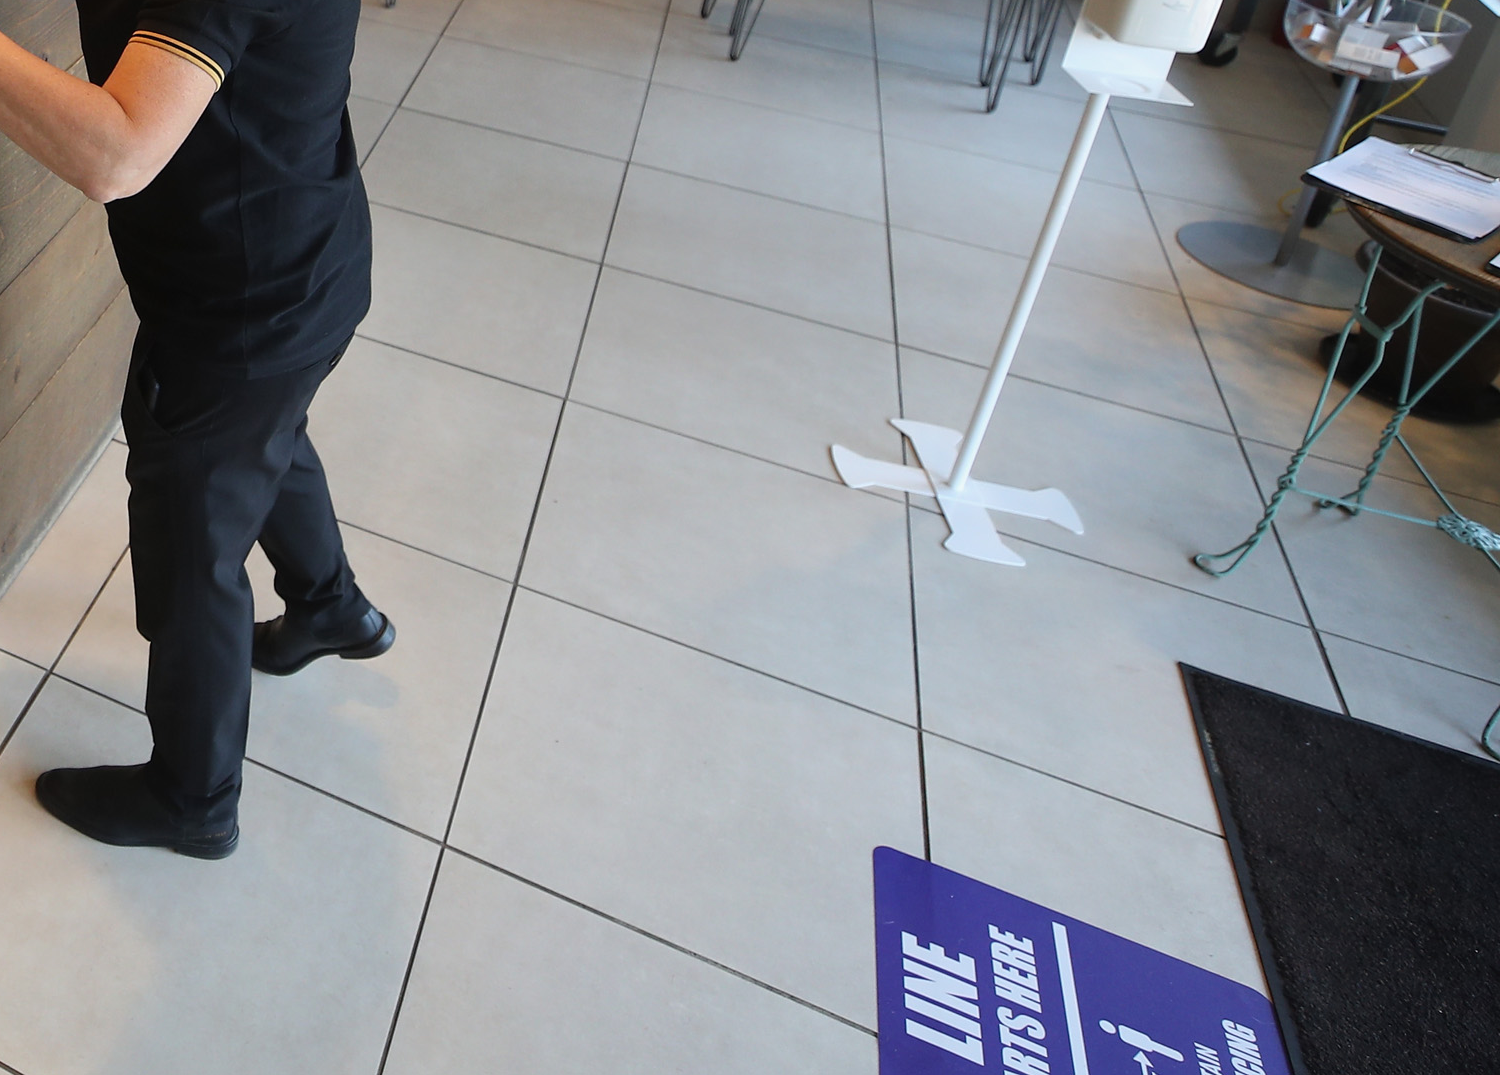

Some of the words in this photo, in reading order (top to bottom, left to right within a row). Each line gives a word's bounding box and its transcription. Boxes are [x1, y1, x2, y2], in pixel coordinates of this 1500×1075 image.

[901, 931, 985, 1066] LINE
[988, 924, 1042, 1014] HERE
[996, 1006, 1051, 1075] RTS
[1222, 1019, 1266, 1075] CING
